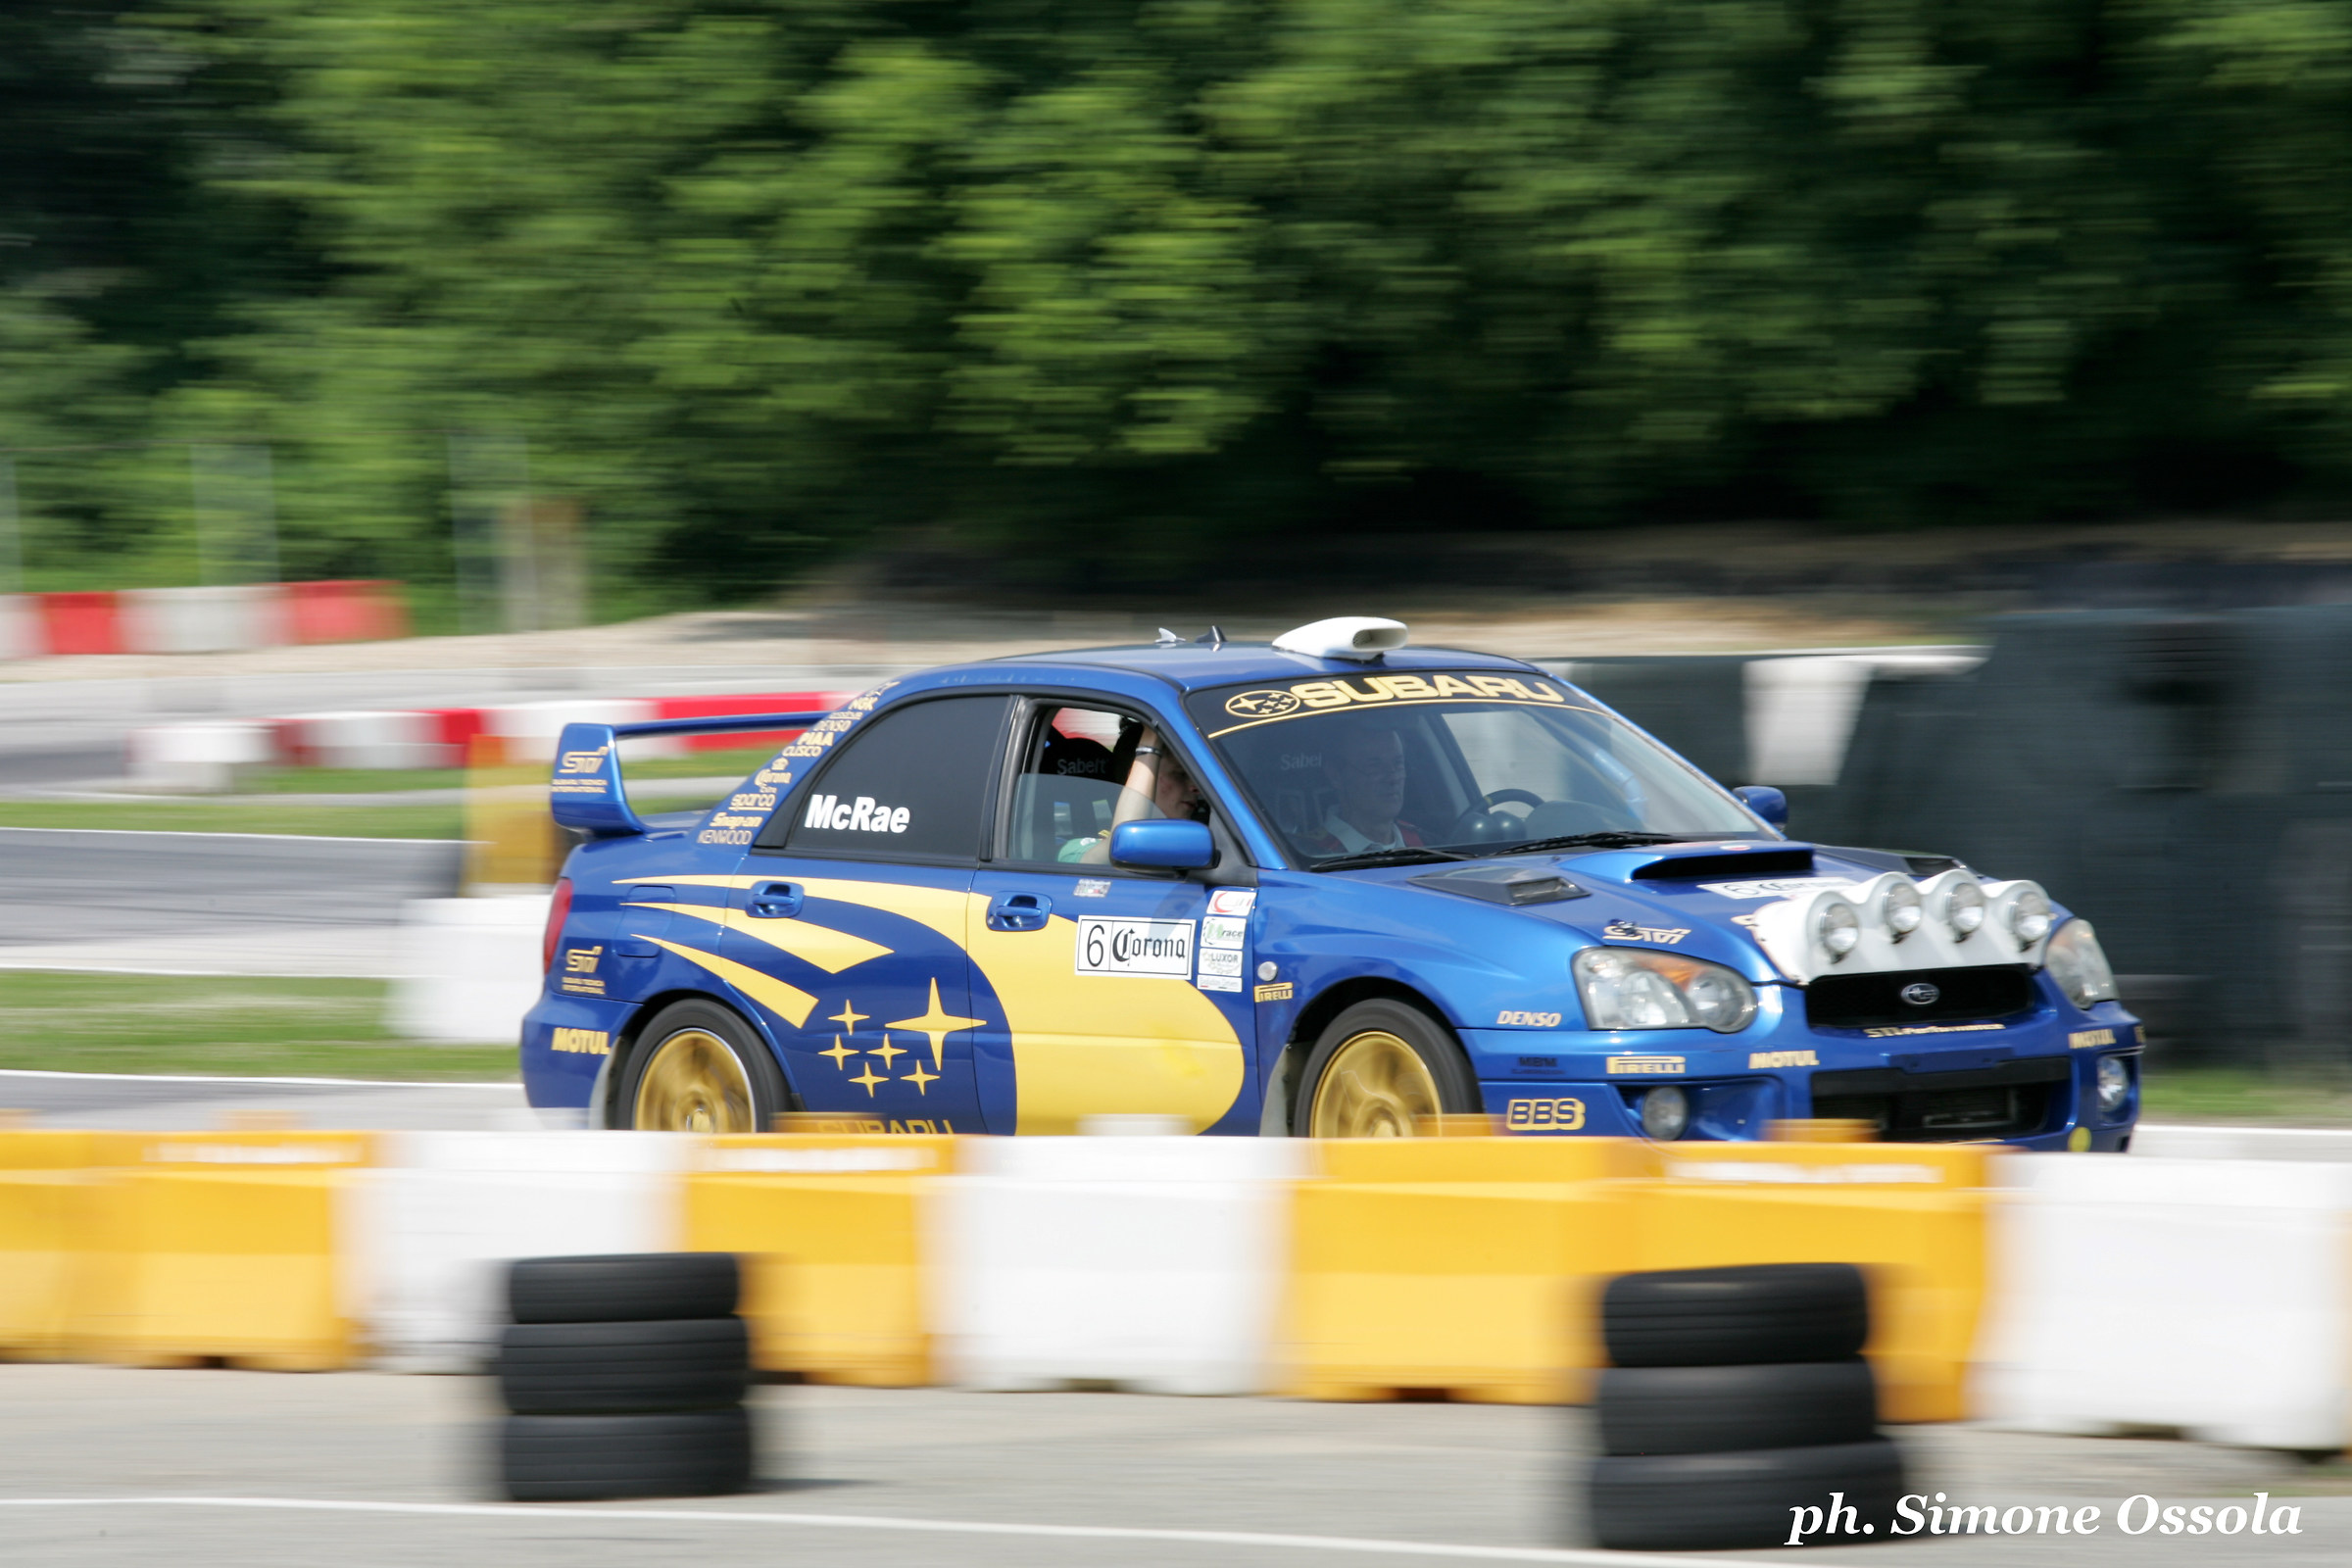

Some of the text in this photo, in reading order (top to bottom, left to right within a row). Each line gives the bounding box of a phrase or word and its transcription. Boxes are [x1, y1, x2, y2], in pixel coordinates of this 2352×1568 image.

[1296, 674, 1565, 705] SUBARU
[796, 731, 834, 746] PIAA
[1280, 752, 1322, 771] Sabel
[728, 793, 775, 811] sparco
[804, 794, 910, 834] McRae
[696, 829, 753, 845] KENWOOD
[1086, 924, 1186, 967] 6 Corona
[1211, 953, 1239, 963] LUXOR
[1253, 982, 1294, 1003] PIRELLI
[1496, 1010, 1562, 1027] DENSO
[551, 1027, 611, 1054] MOTUL
[1606, 1055, 1686, 1074] PIRELLI
[1749, 1051, 1820, 1069] MOTUL
[1506, 1098, 1586, 1130] BBS
